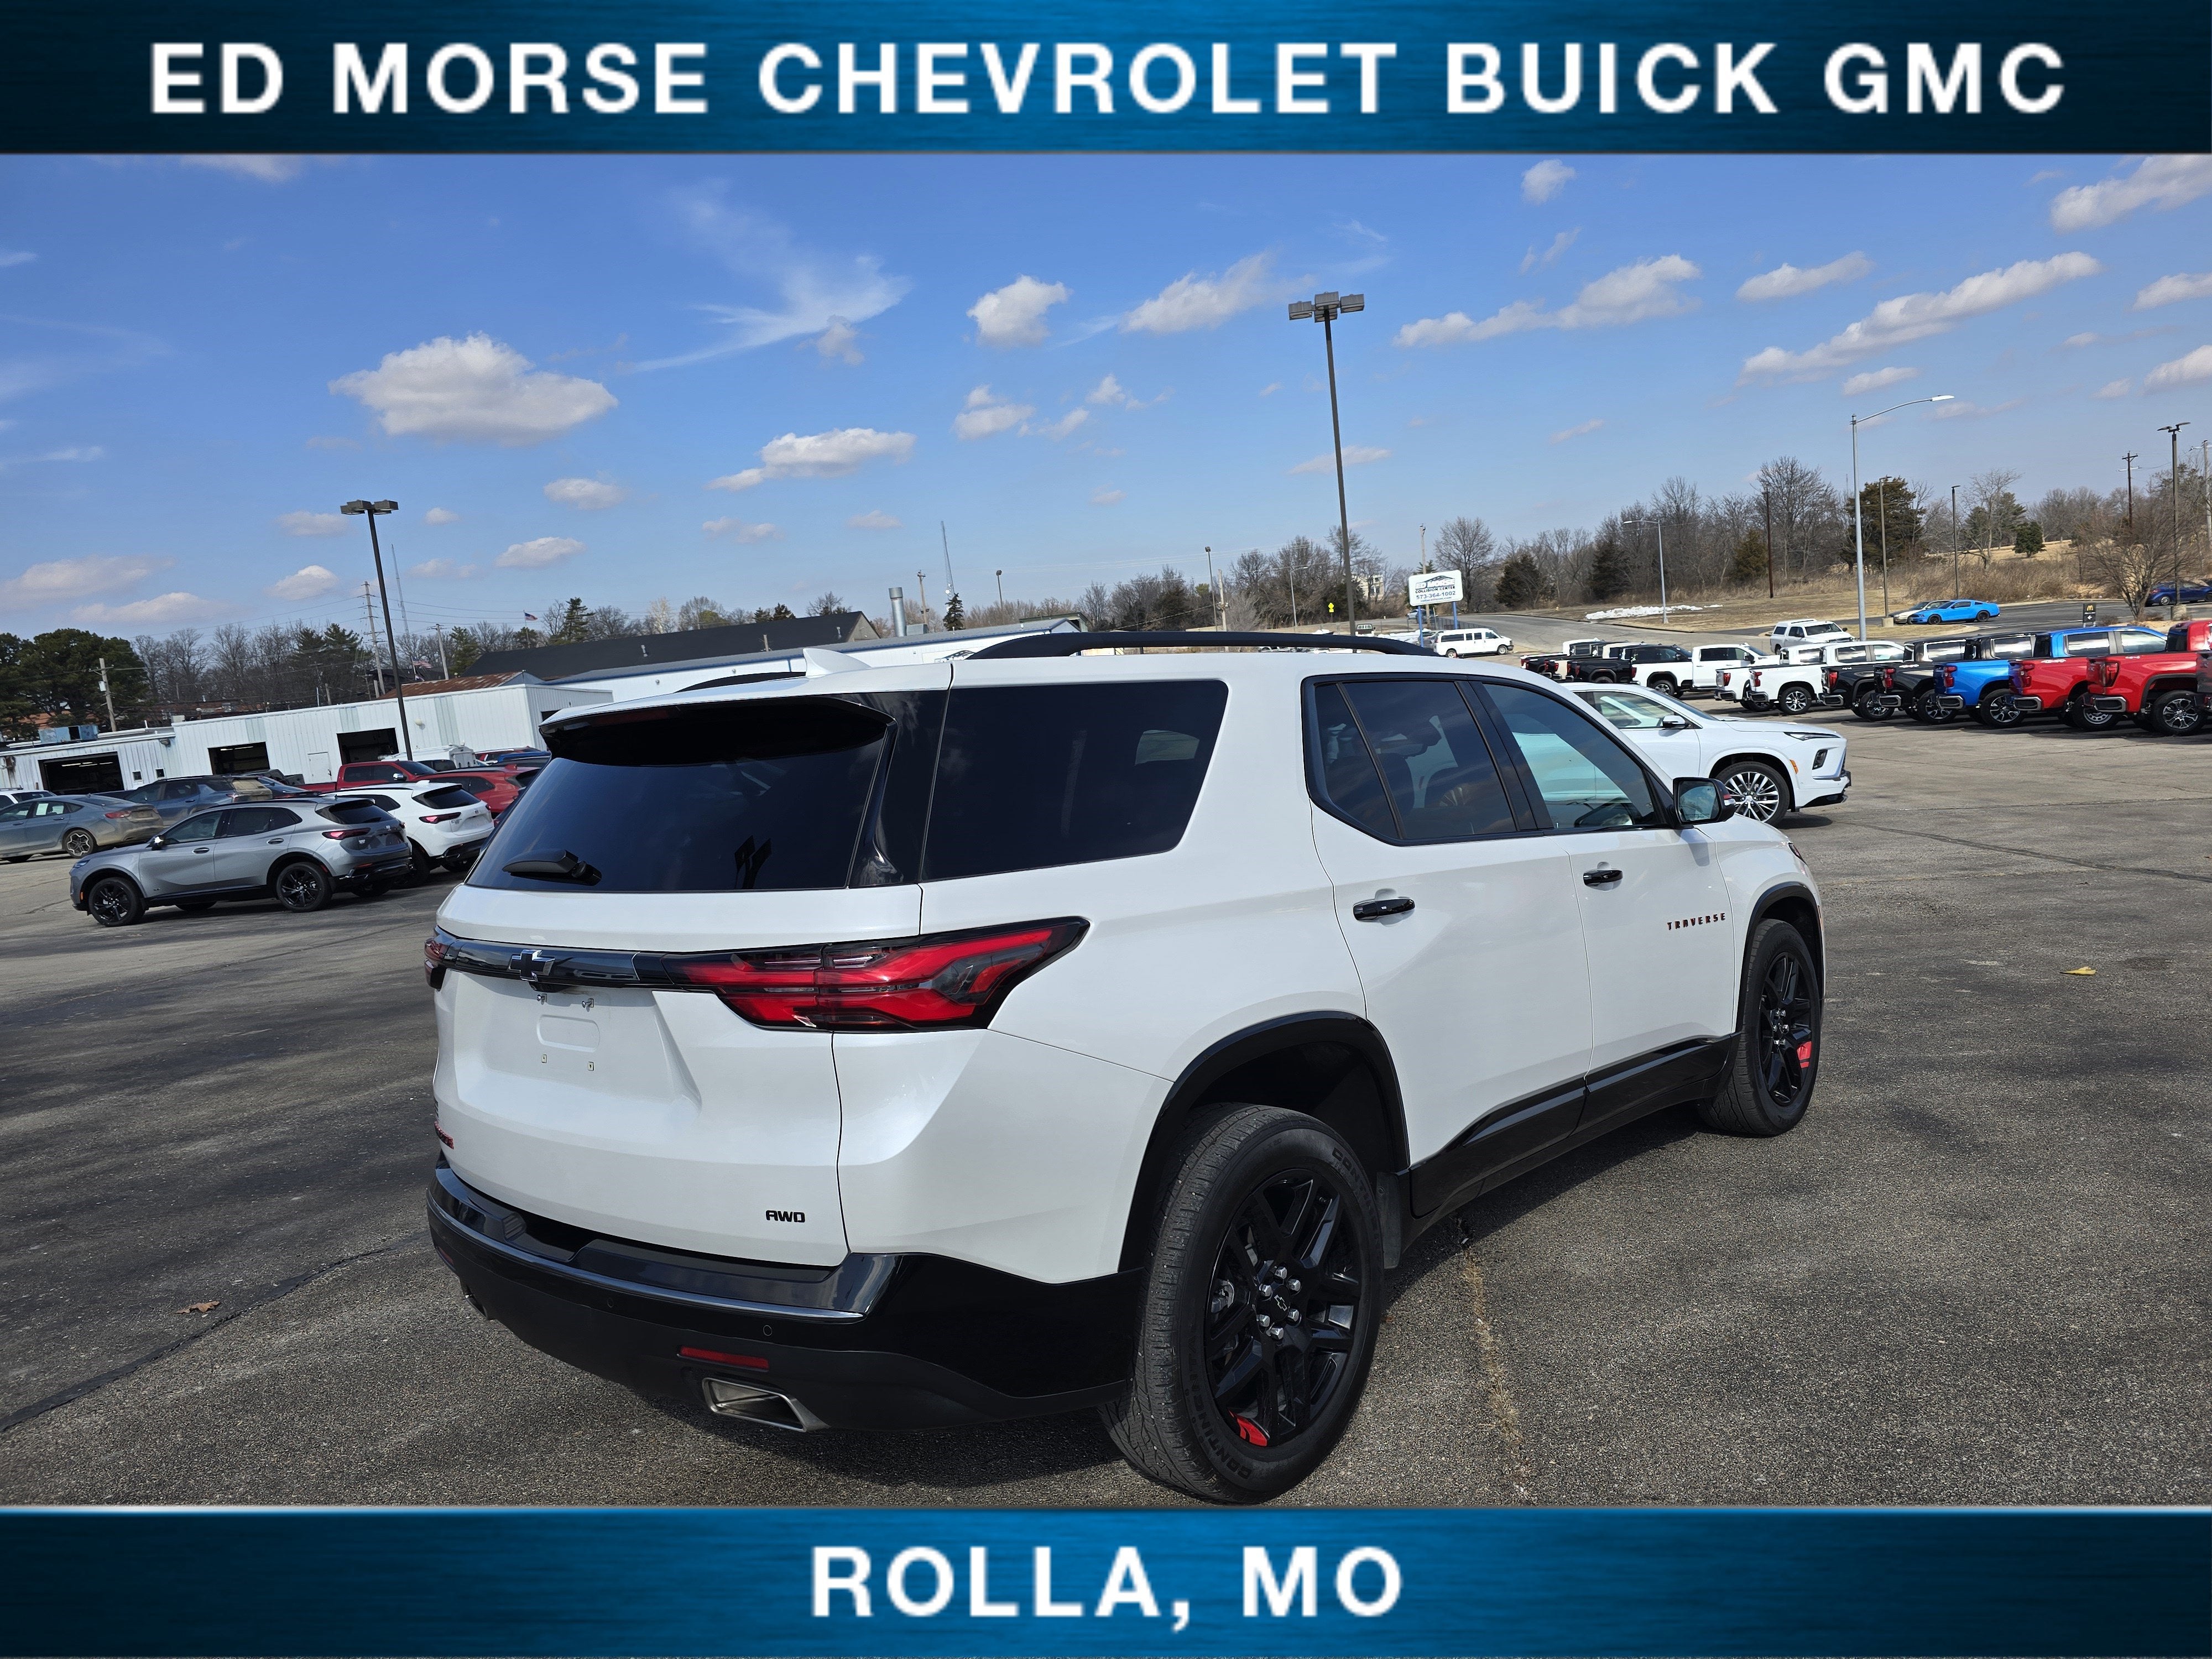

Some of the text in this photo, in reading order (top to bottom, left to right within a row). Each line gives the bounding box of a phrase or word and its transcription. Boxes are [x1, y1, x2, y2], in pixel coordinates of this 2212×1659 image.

[1416, 591, 1455, 599] 573-364-1002
[1667, 912, 1726, 931] TRAVERSE
[765, 1209, 806, 1223] AWD
